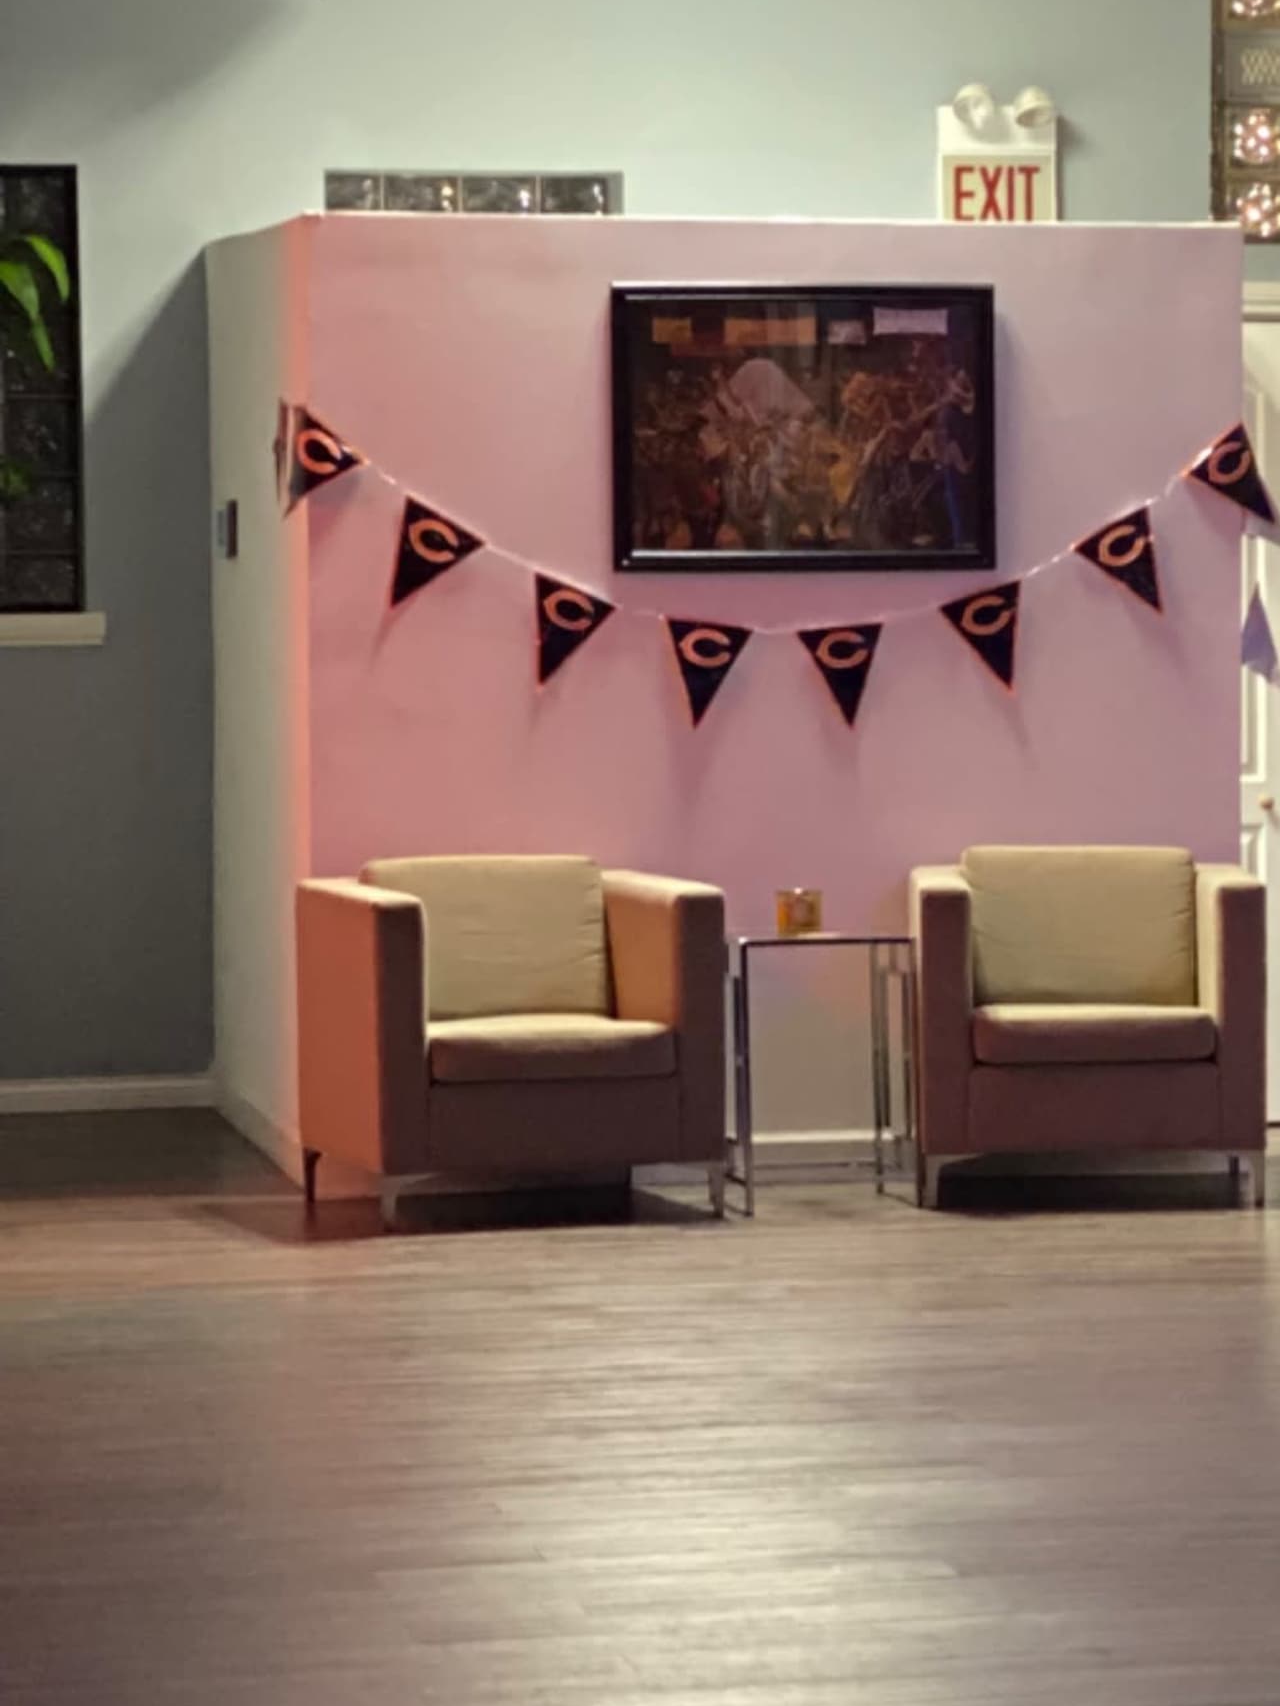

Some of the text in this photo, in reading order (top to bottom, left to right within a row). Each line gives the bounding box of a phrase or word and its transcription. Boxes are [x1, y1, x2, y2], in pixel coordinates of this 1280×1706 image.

[954, 166, 1040, 221] EXIT
[297, 428, 342, 474] C
[1208, 441, 1251, 484] C
[408, 518, 459, 564] C
[1099, 524, 1146, 567] C
[543, 588, 596, 631] C
[961, 595, 1013, 636] C
[679, 628, 732, 667] C
[815, 631, 868, 669] C
